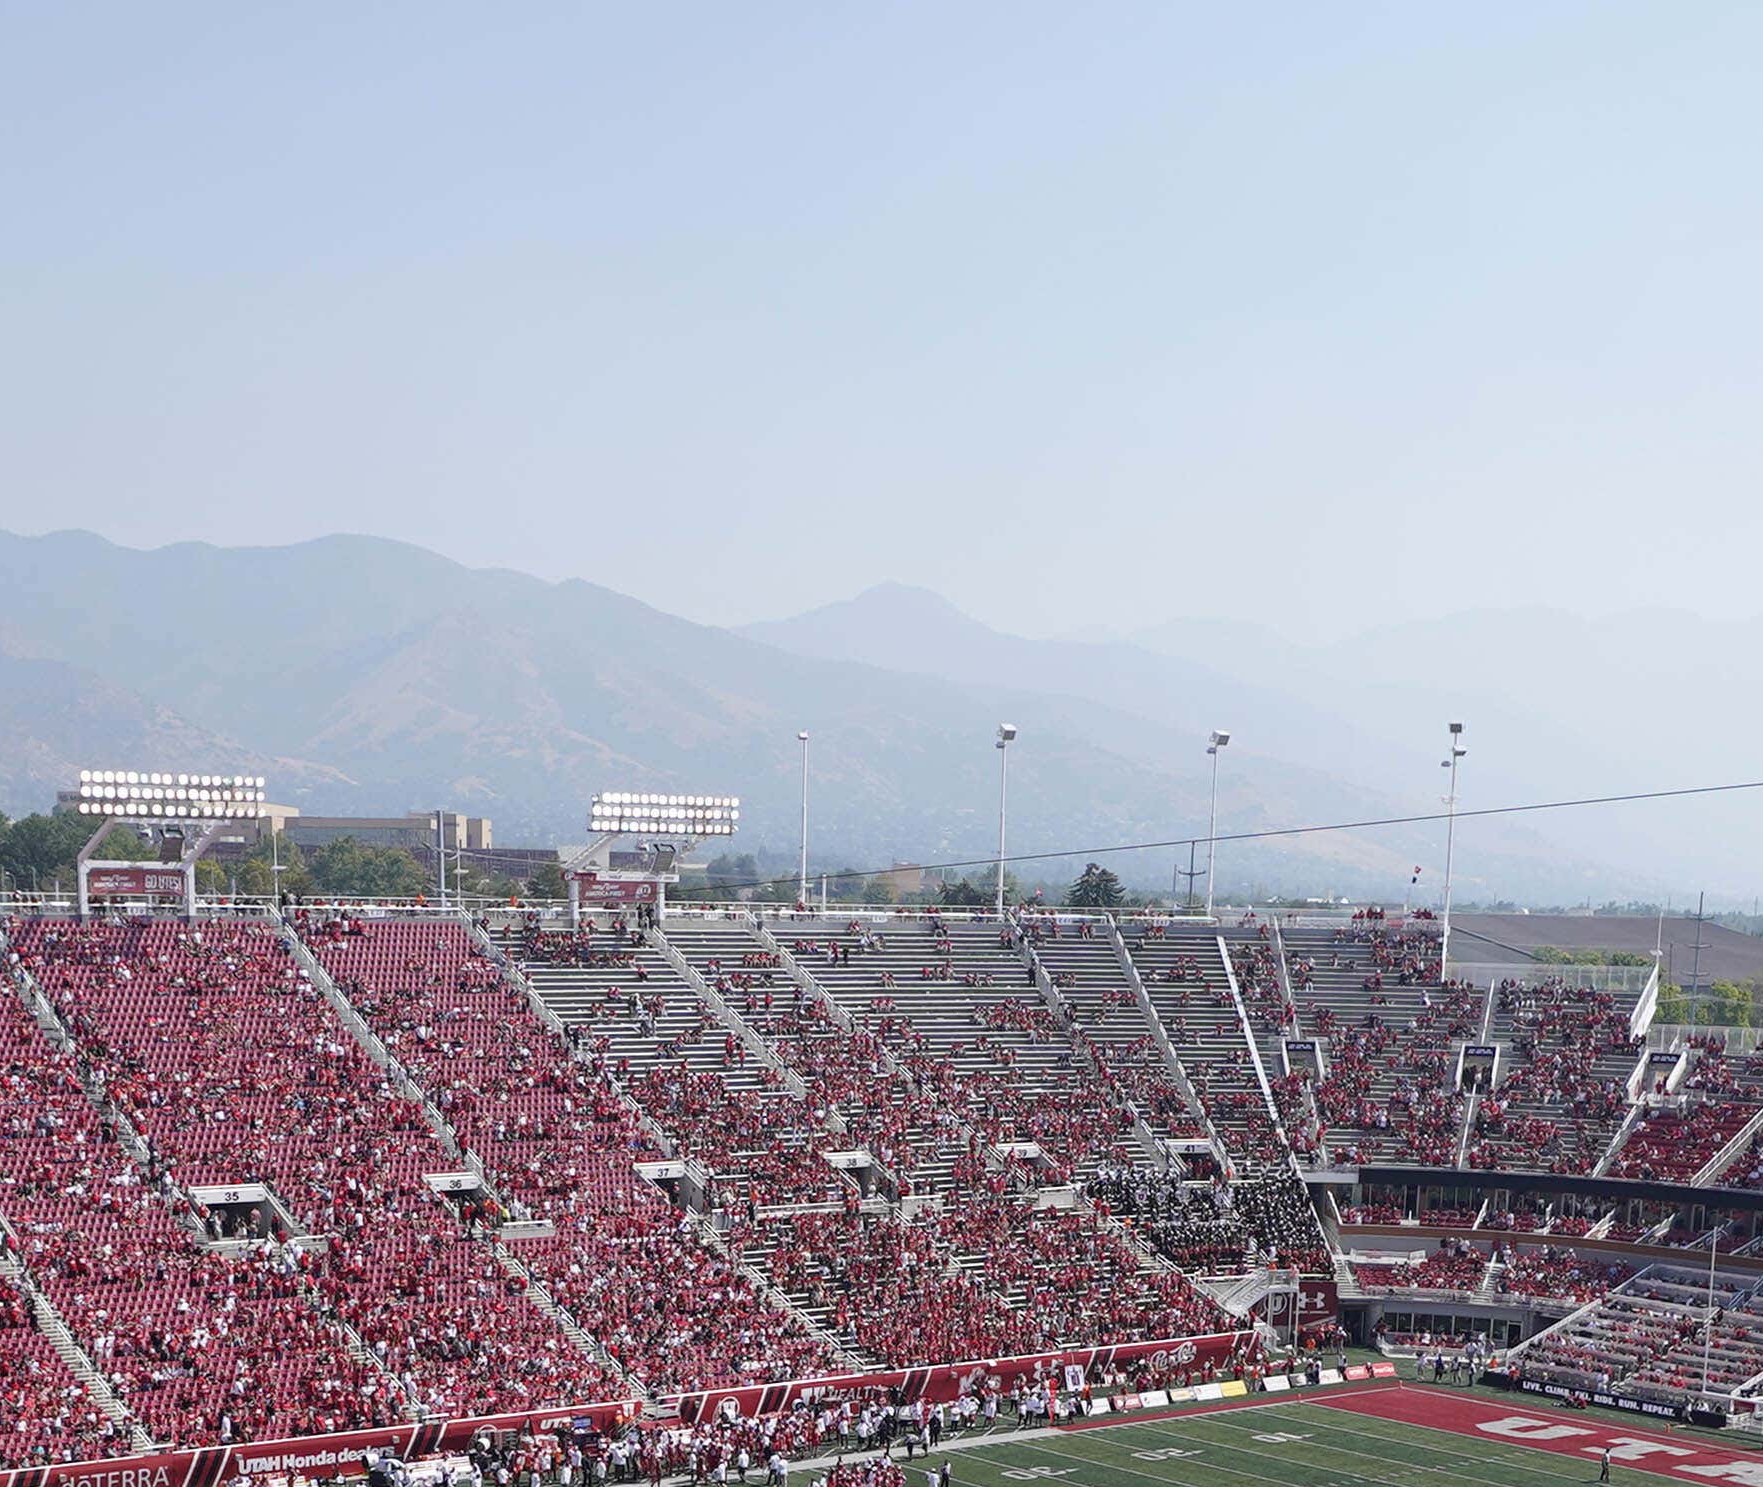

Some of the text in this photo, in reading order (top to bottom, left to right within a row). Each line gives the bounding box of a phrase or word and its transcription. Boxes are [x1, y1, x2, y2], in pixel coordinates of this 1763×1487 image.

[657, 1168, 669, 1178] 37
[449, 1180, 462, 1189] 36
[224, 1191, 239, 1201] 35
[1522, 1381, 1542, 1393] LIVE.
[1593, 1395, 1616, 1406] RIDE.
[1618, 1398, 1639, 1410] RUN.
[1641, 1403, 1676, 1417] REPEAT.
[1251, 1432, 1303, 1443] 10
[238, 1444, 396, 1475] UTAH Honda dealers
